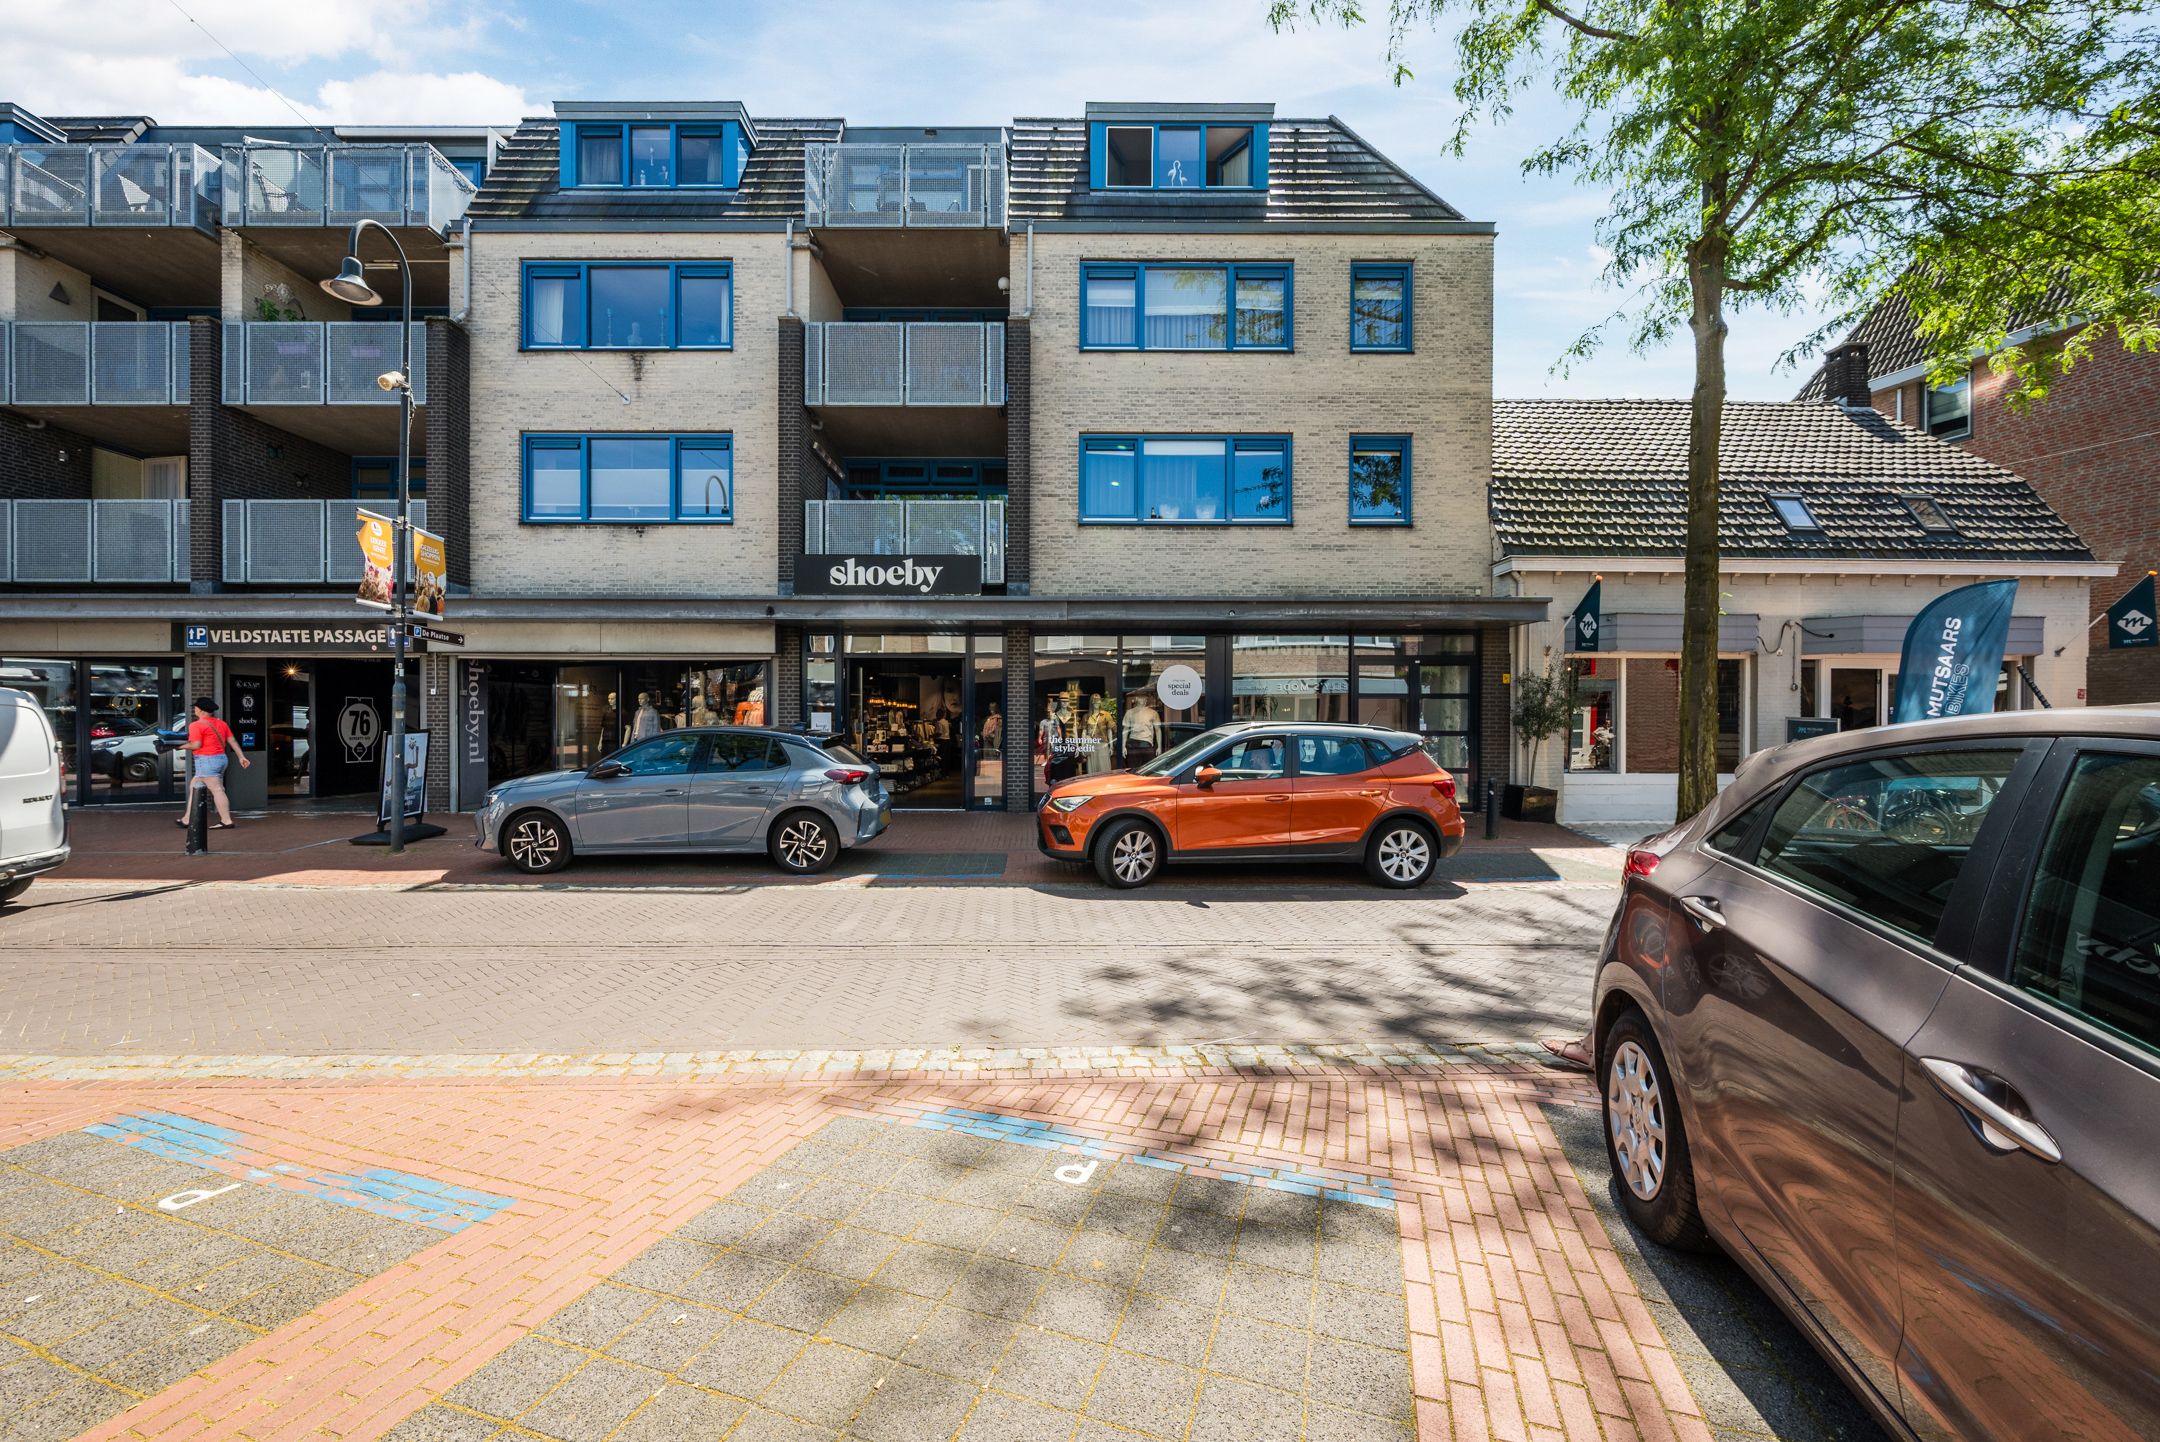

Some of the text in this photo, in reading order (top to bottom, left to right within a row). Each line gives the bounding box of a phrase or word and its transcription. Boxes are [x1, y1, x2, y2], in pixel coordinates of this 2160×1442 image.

[829, 557, 944, 593] shoeby
[196, 627, 206, 640] P
[210, 629, 311, 643] VELDSTAETE
[313, 629, 387, 643] PASSAGE
[421, 629, 430, 637] De
[430, 631, 450, 641] Plaatse
[1926, 616, 1962, 717] MUTSAARS
[1167, 682, 1191, 690] special
[1945, 663, 1970, 715] BIKES
[118, 695, 134, 707] 76
[465, 658, 485, 764] shoeby.nl
[348, 709, 371, 736] 76
[1049, 735, 1102, 744] the summer
[1054, 743, 1096, 754] style edit
